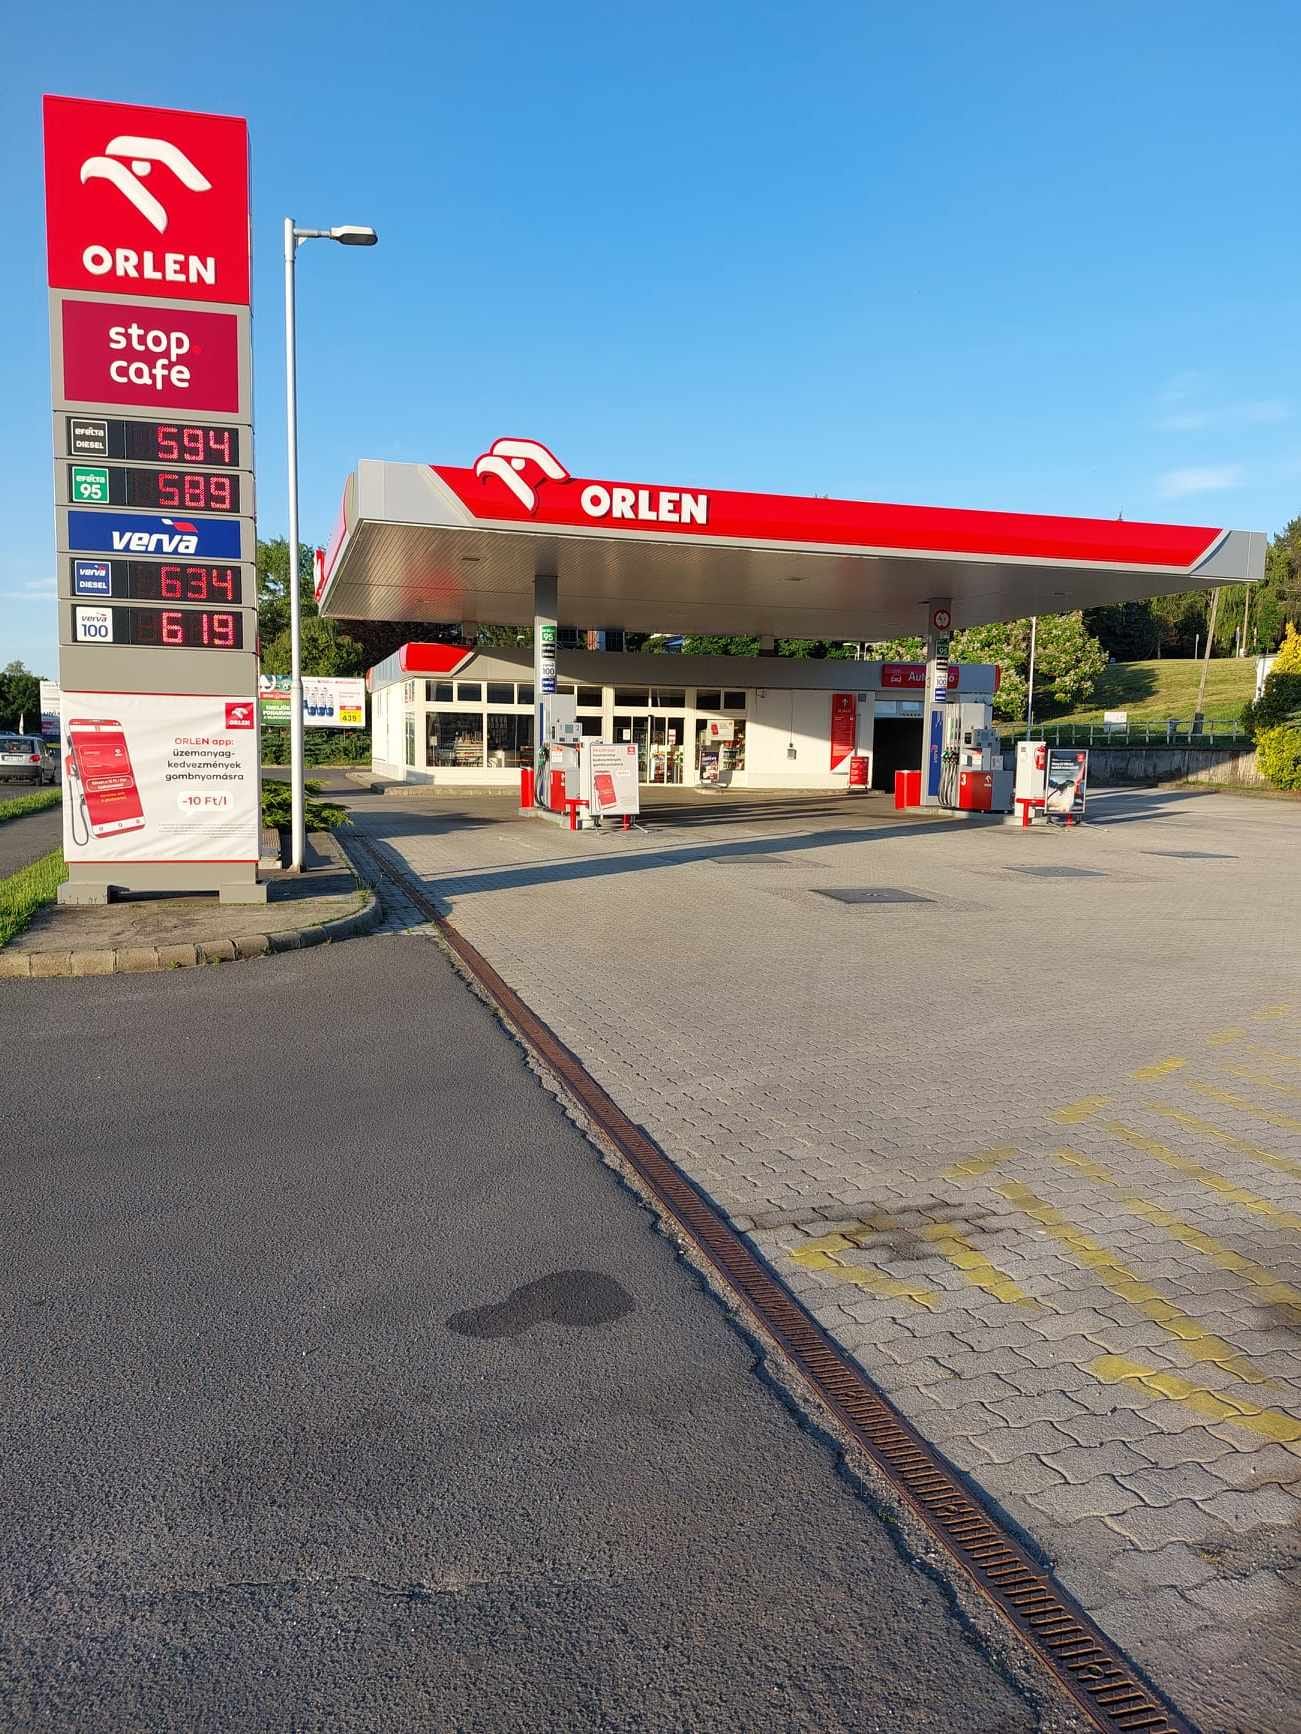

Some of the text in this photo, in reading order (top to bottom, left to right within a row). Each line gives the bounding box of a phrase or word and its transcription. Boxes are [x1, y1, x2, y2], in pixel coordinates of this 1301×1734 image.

[82, 244, 216, 286] ORLEN
[109, 323, 191, 363] stop
[109, 358, 192, 391] cafe
[76, 440, 105, 449] DIESEL
[157, 425, 231, 463] 594
[80, 484, 102, 499] 95
[158, 473, 232, 510] 589
[580, 484, 708, 525] ORLEN
[111, 530, 199, 555] verva
[79, 568, 106, 577] verva
[79, 580, 107, 589] DIESEL
[160, 566, 233, 601] 634
[81, 614, 107, 623] verva
[81, 624, 109, 638] 100
[162, 611, 233, 646] 619
[174, 737, 235, 748] ORLEN app:
[172, 748, 236, 760] üzemanyag-
[167, 759, 242, 771] kedvezmények
[165, 770, 244, 783] gombnyomásra
[961, 773, 967, 786] 3
[182, 796, 202, 807] -10
